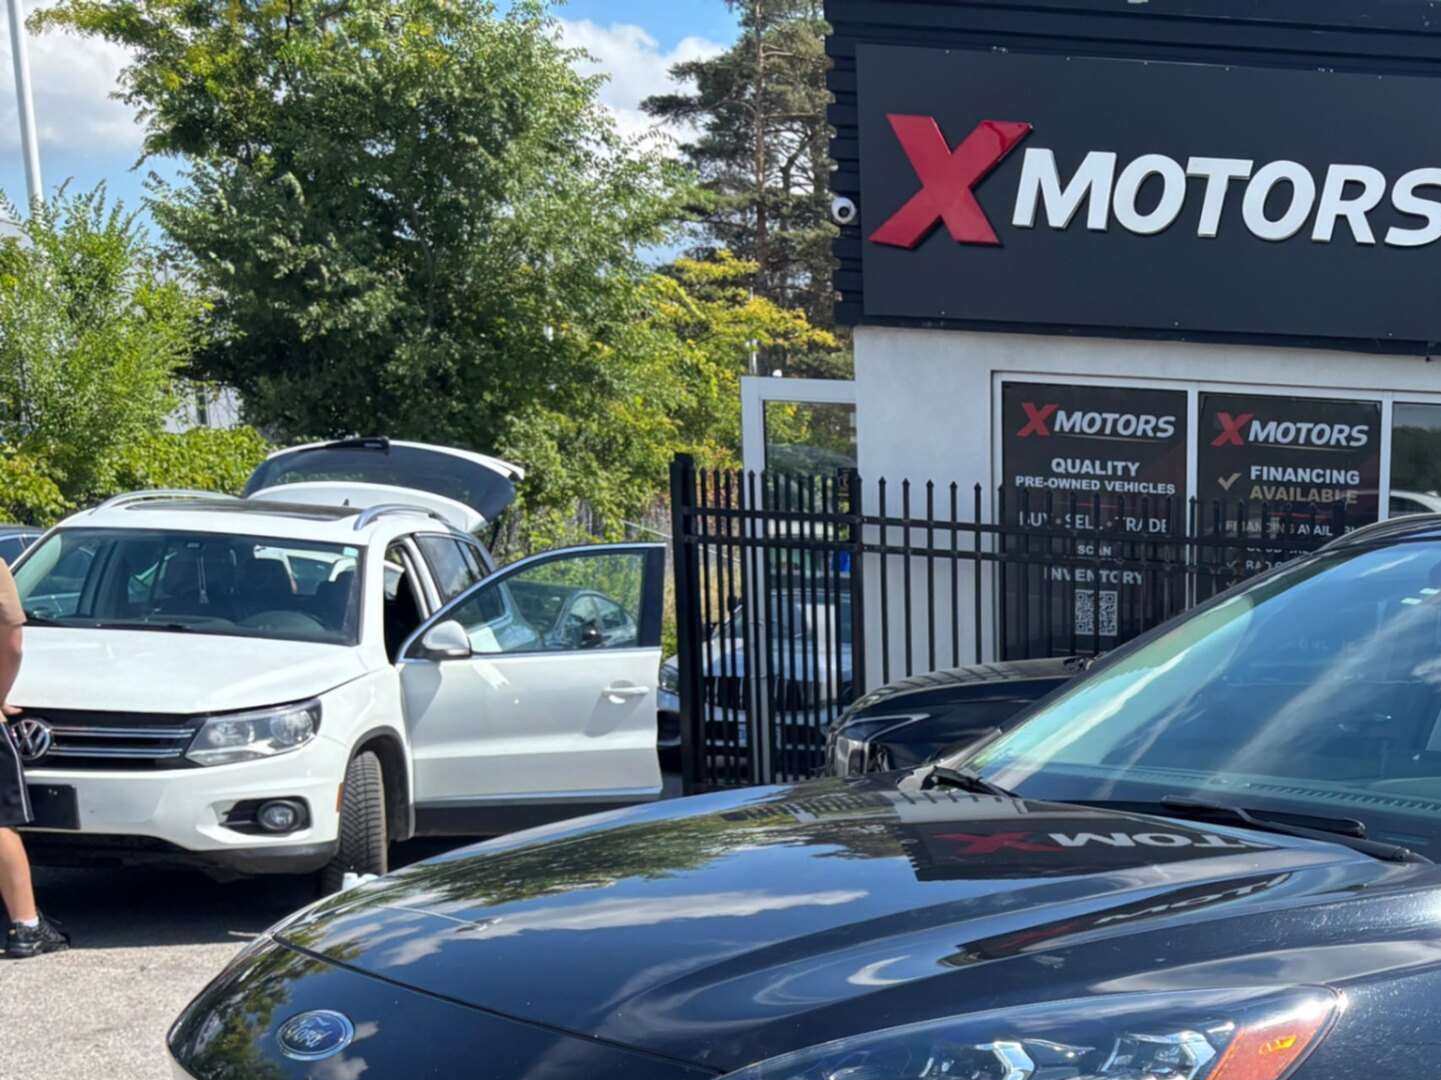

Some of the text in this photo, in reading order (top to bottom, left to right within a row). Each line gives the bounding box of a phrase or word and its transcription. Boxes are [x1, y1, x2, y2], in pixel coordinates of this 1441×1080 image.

[1053, 409, 1176, 439] MOTORS
[1247, 420, 1369, 448] MOTORS
[1051, 457, 1140, 478] QUALITY
[1250, 465, 1360, 485] FINANCING
[1015, 475, 1176, 494] PRE-OWNED VEHICLES
[1250, 485, 1359, 504] AVAILABLE
